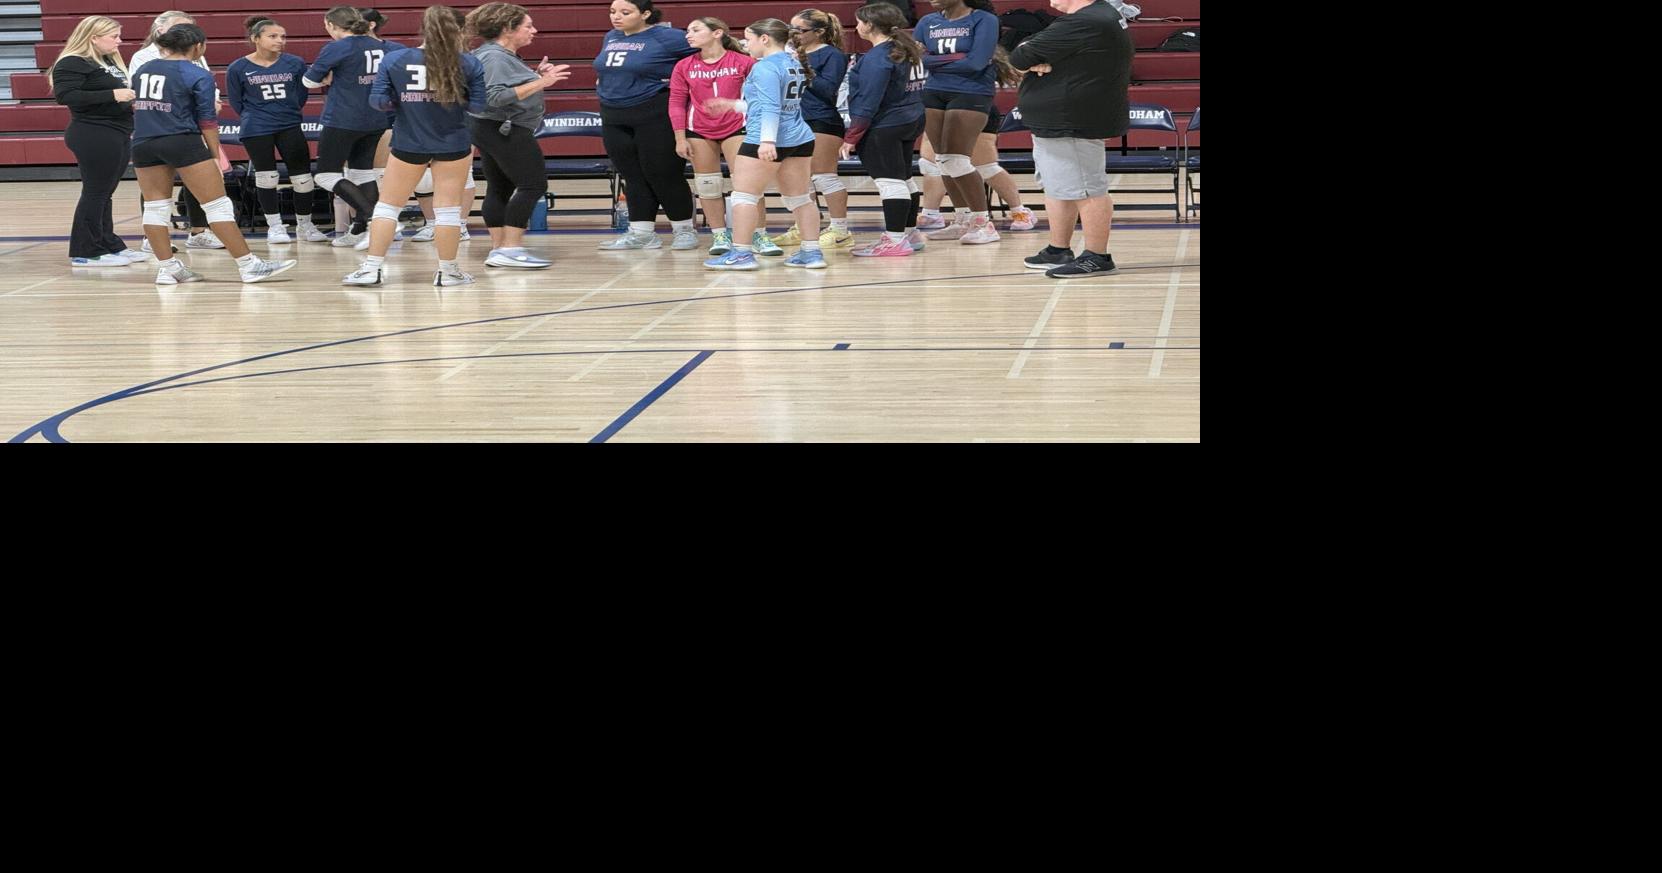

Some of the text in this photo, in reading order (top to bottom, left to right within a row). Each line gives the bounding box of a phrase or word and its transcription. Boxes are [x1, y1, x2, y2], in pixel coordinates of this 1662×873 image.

[938, 38, 957, 54] 14
[605, 52, 628, 67] 15
[406, 64, 436, 91] 3
[689, 67, 739, 79] WINDHAM
[139, 73, 166, 100] 10
[260, 84, 287, 100] 25
[712, 81, 718, 97] 1
[543, 118, 603, 127] WINDHAM
